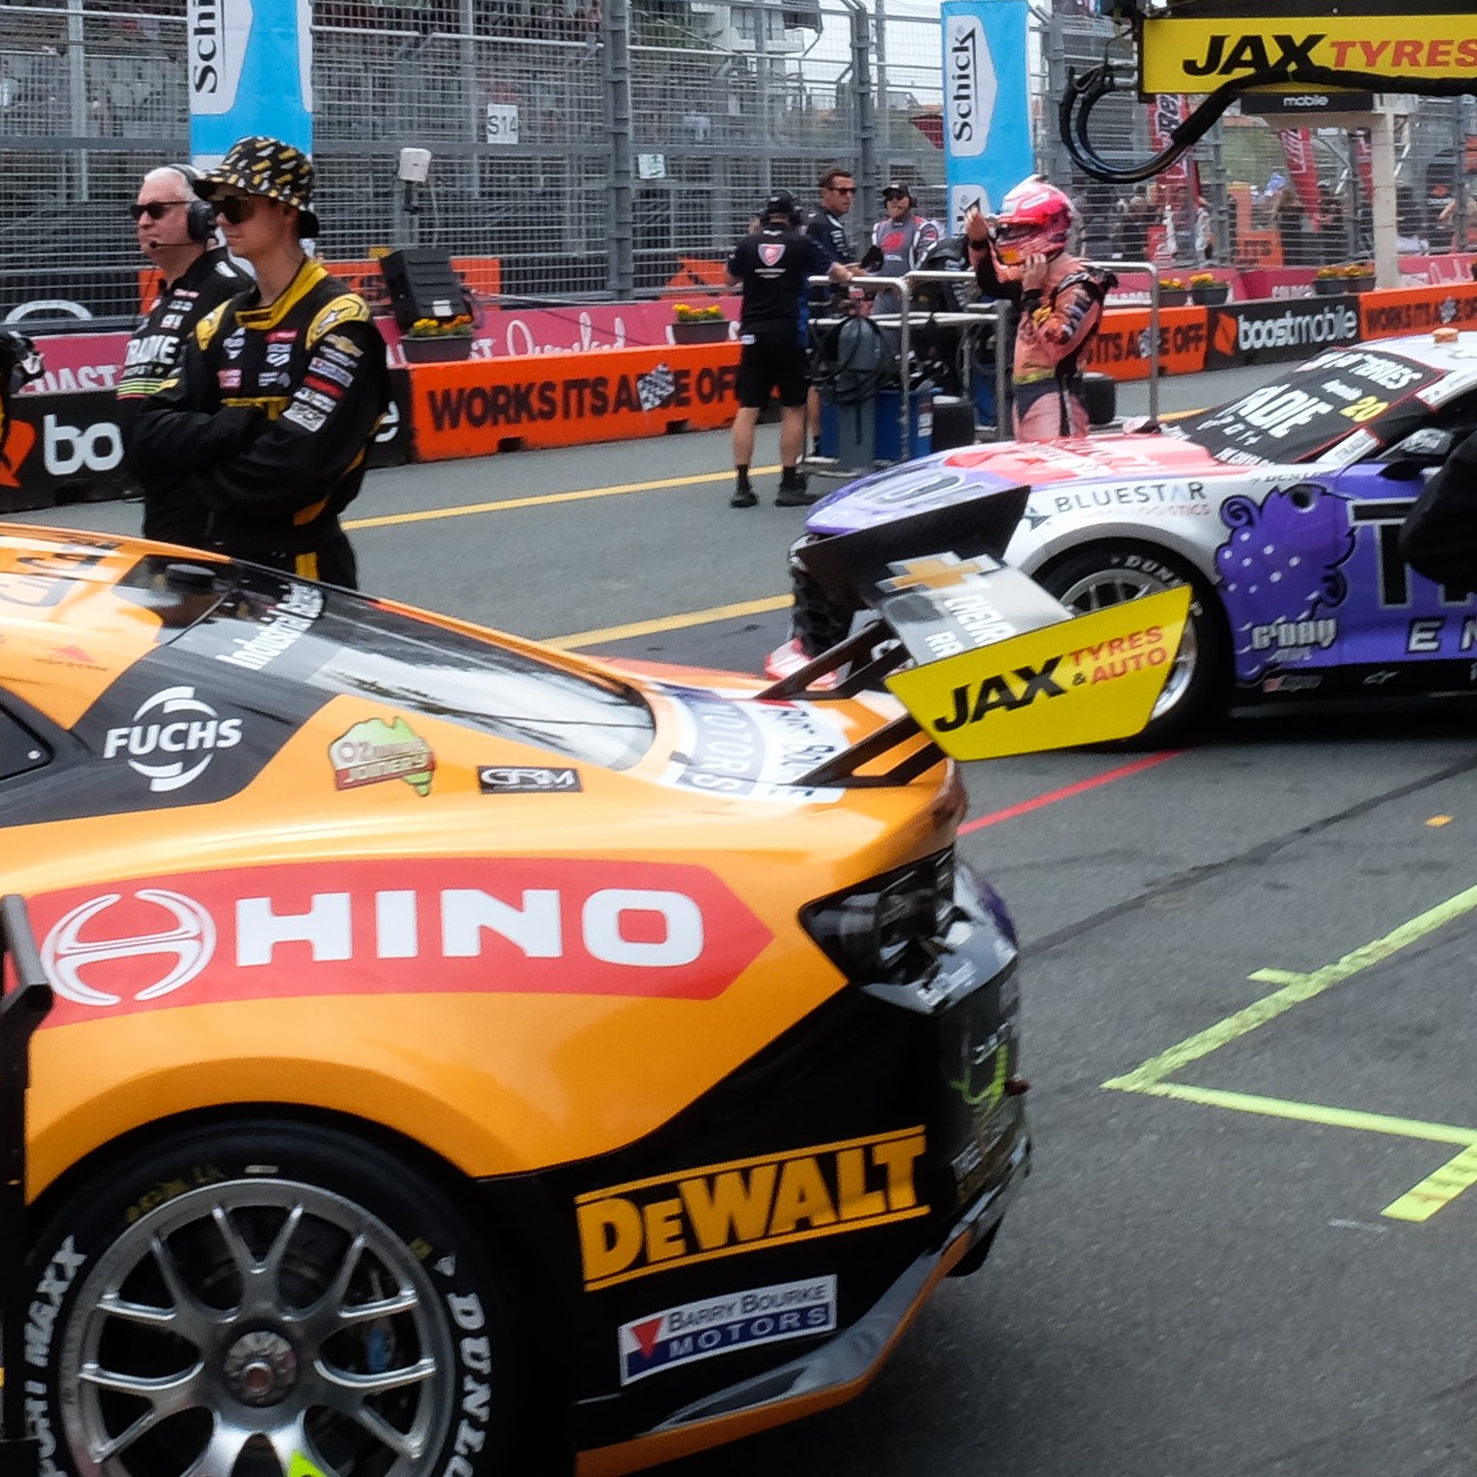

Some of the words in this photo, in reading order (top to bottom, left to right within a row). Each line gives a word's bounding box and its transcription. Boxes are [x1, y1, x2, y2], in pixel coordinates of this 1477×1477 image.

[1181, 32, 1328, 77] JAX
[951, 26, 976, 143] Schick
[1282, 95, 1330, 107] mobile
[426, 379, 558, 433] WORKS
[561, 376, 609, 420] ITS
[1338, 395, 1390, 424] 20
[1054, 480, 1208, 513] BLUESTAR
[1070, 625, 1164, 668] TYRES
[1071, 671, 1088, 687] &
[1090, 646, 1167, 685] AUTO
[932, 654, 1068, 733] JAX
[103, 717, 243, 759] FUCHS
[234, 887, 705, 967] HINO
[668, 1306, 828, 1360] MOTORS
